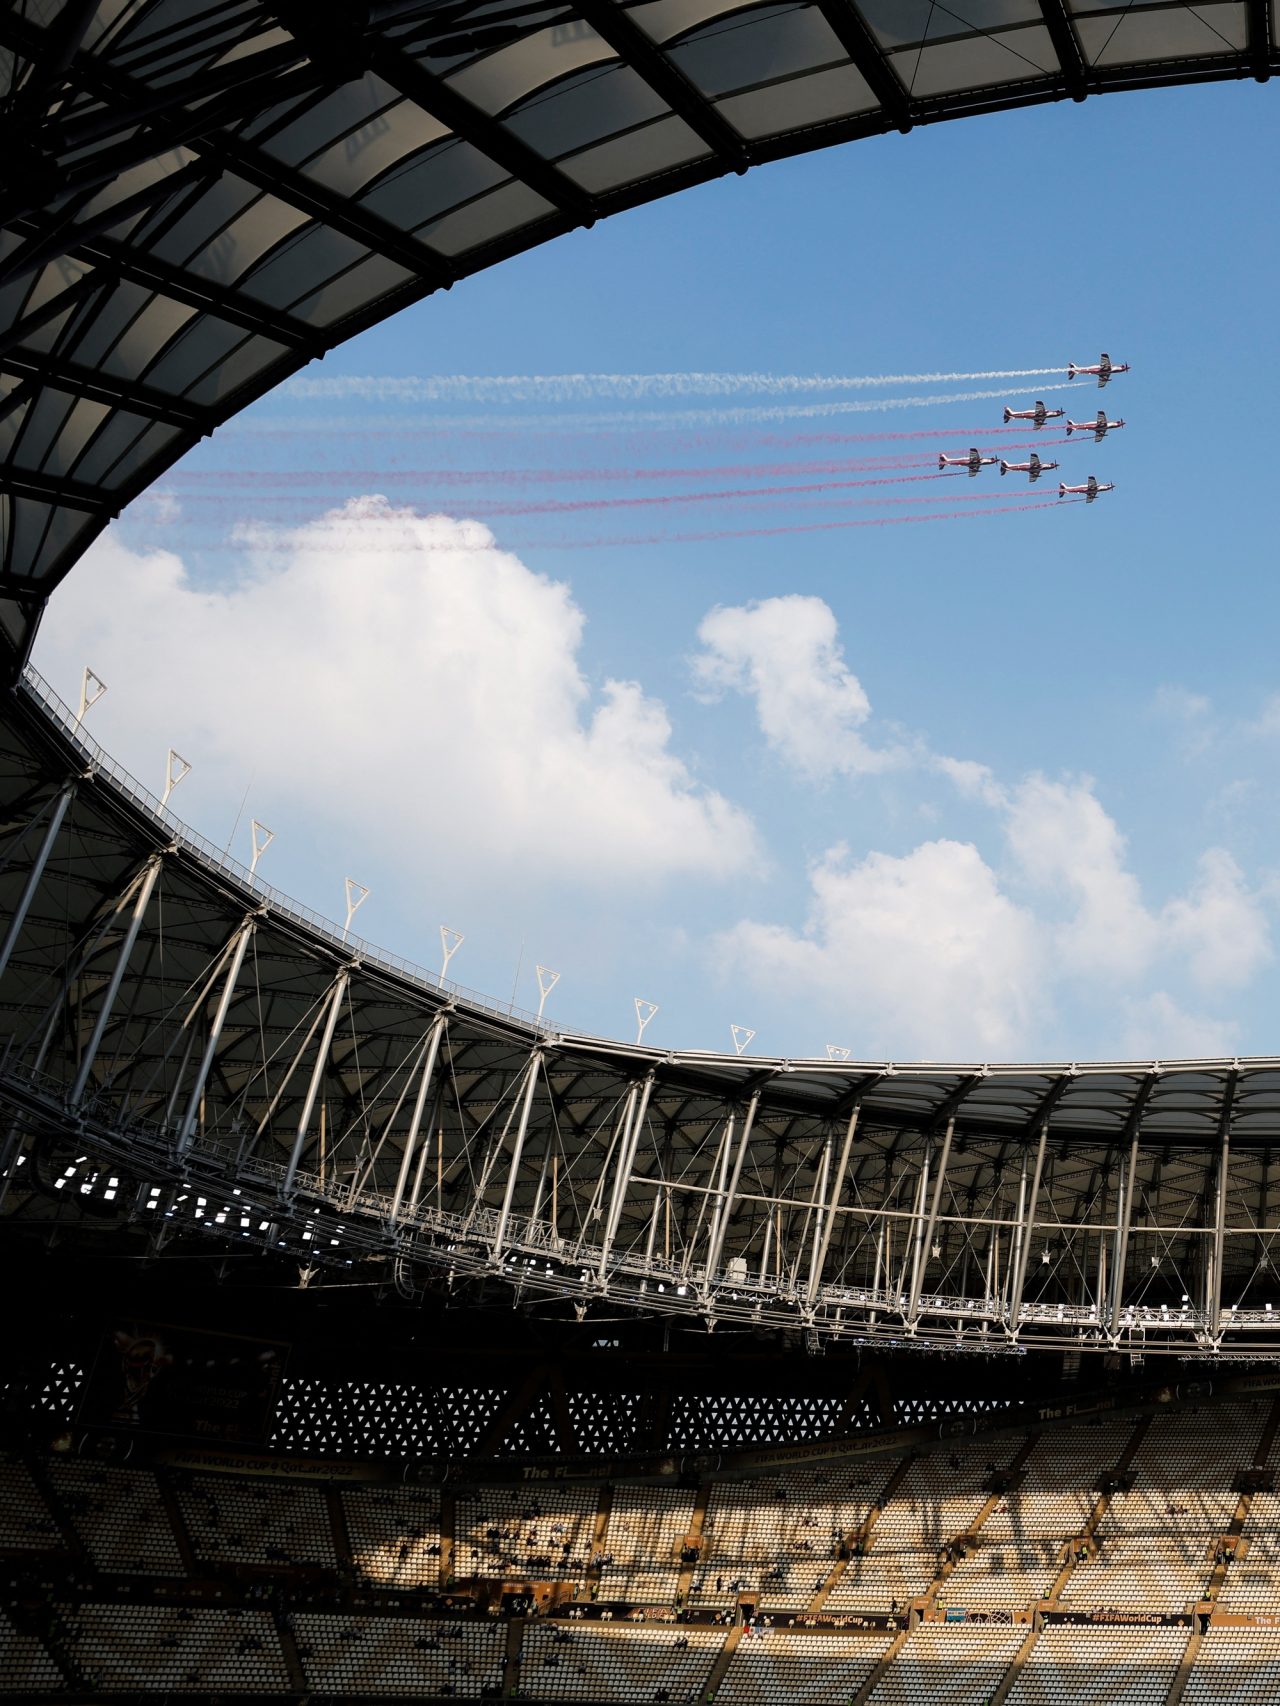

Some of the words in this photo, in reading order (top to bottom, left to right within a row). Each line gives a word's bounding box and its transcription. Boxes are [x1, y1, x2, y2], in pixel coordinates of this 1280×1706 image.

[1038, 1407, 1062, 1420] The
[754, 1452, 777, 1463] FIFA
[776, 1449, 810, 1461] WORLD
[811, 1445, 830, 1456] CUP
[174, 1451, 201, 1463] FIFA
[201, 1454, 244, 1468] WORLD
[246, 1459, 269, 1471] CUP
[522, 1466, 548, 1479] The
[795, 1614, 863, 1625] #FIFAWorldCup
[1092, 1614, 1162, 1624] #FIFAWorldCup
[1255, 1616, 1271, 1624] The
